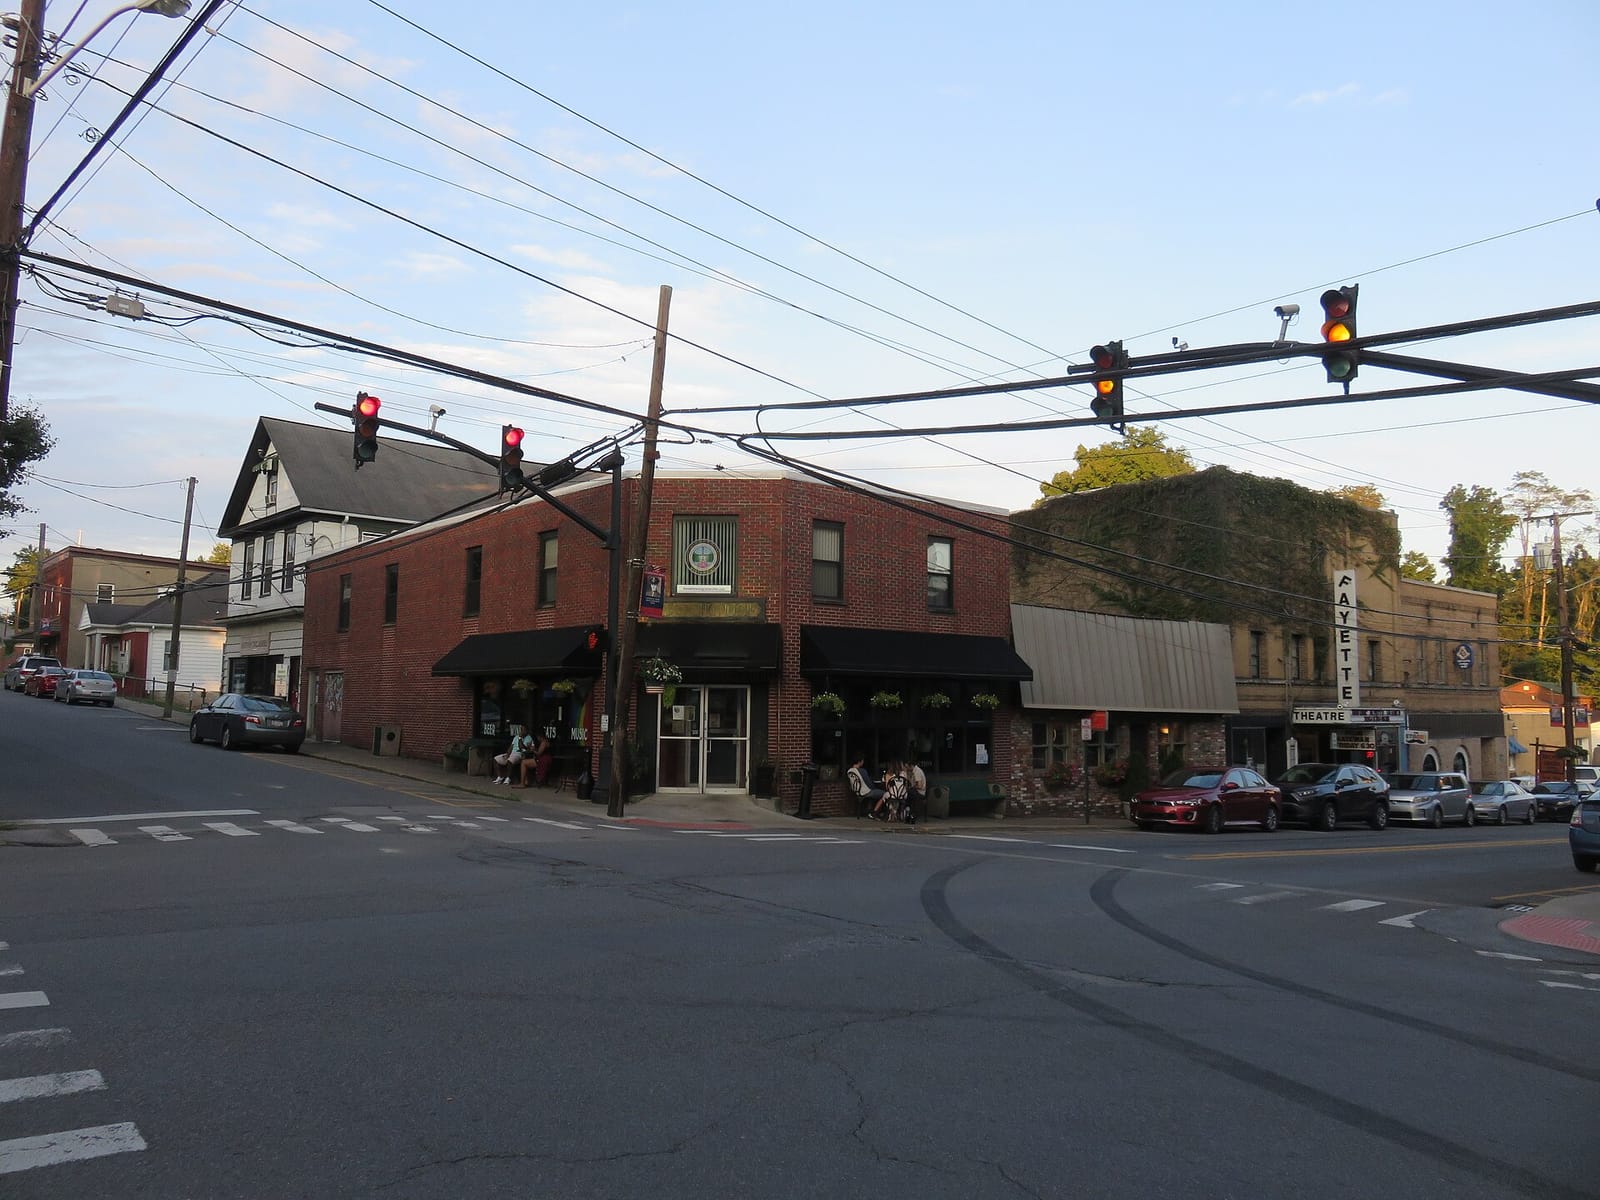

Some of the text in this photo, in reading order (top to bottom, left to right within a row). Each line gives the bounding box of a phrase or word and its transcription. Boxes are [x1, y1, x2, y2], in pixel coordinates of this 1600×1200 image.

[1338, 575, 1353, 700] FAYETTE
[1293, 711, 1345, 721] THEATRE
[483, 722, 496, 736] BEER
[543, 726, 557, 739] ATS
[570, 727, 588, 741] MUSIC
